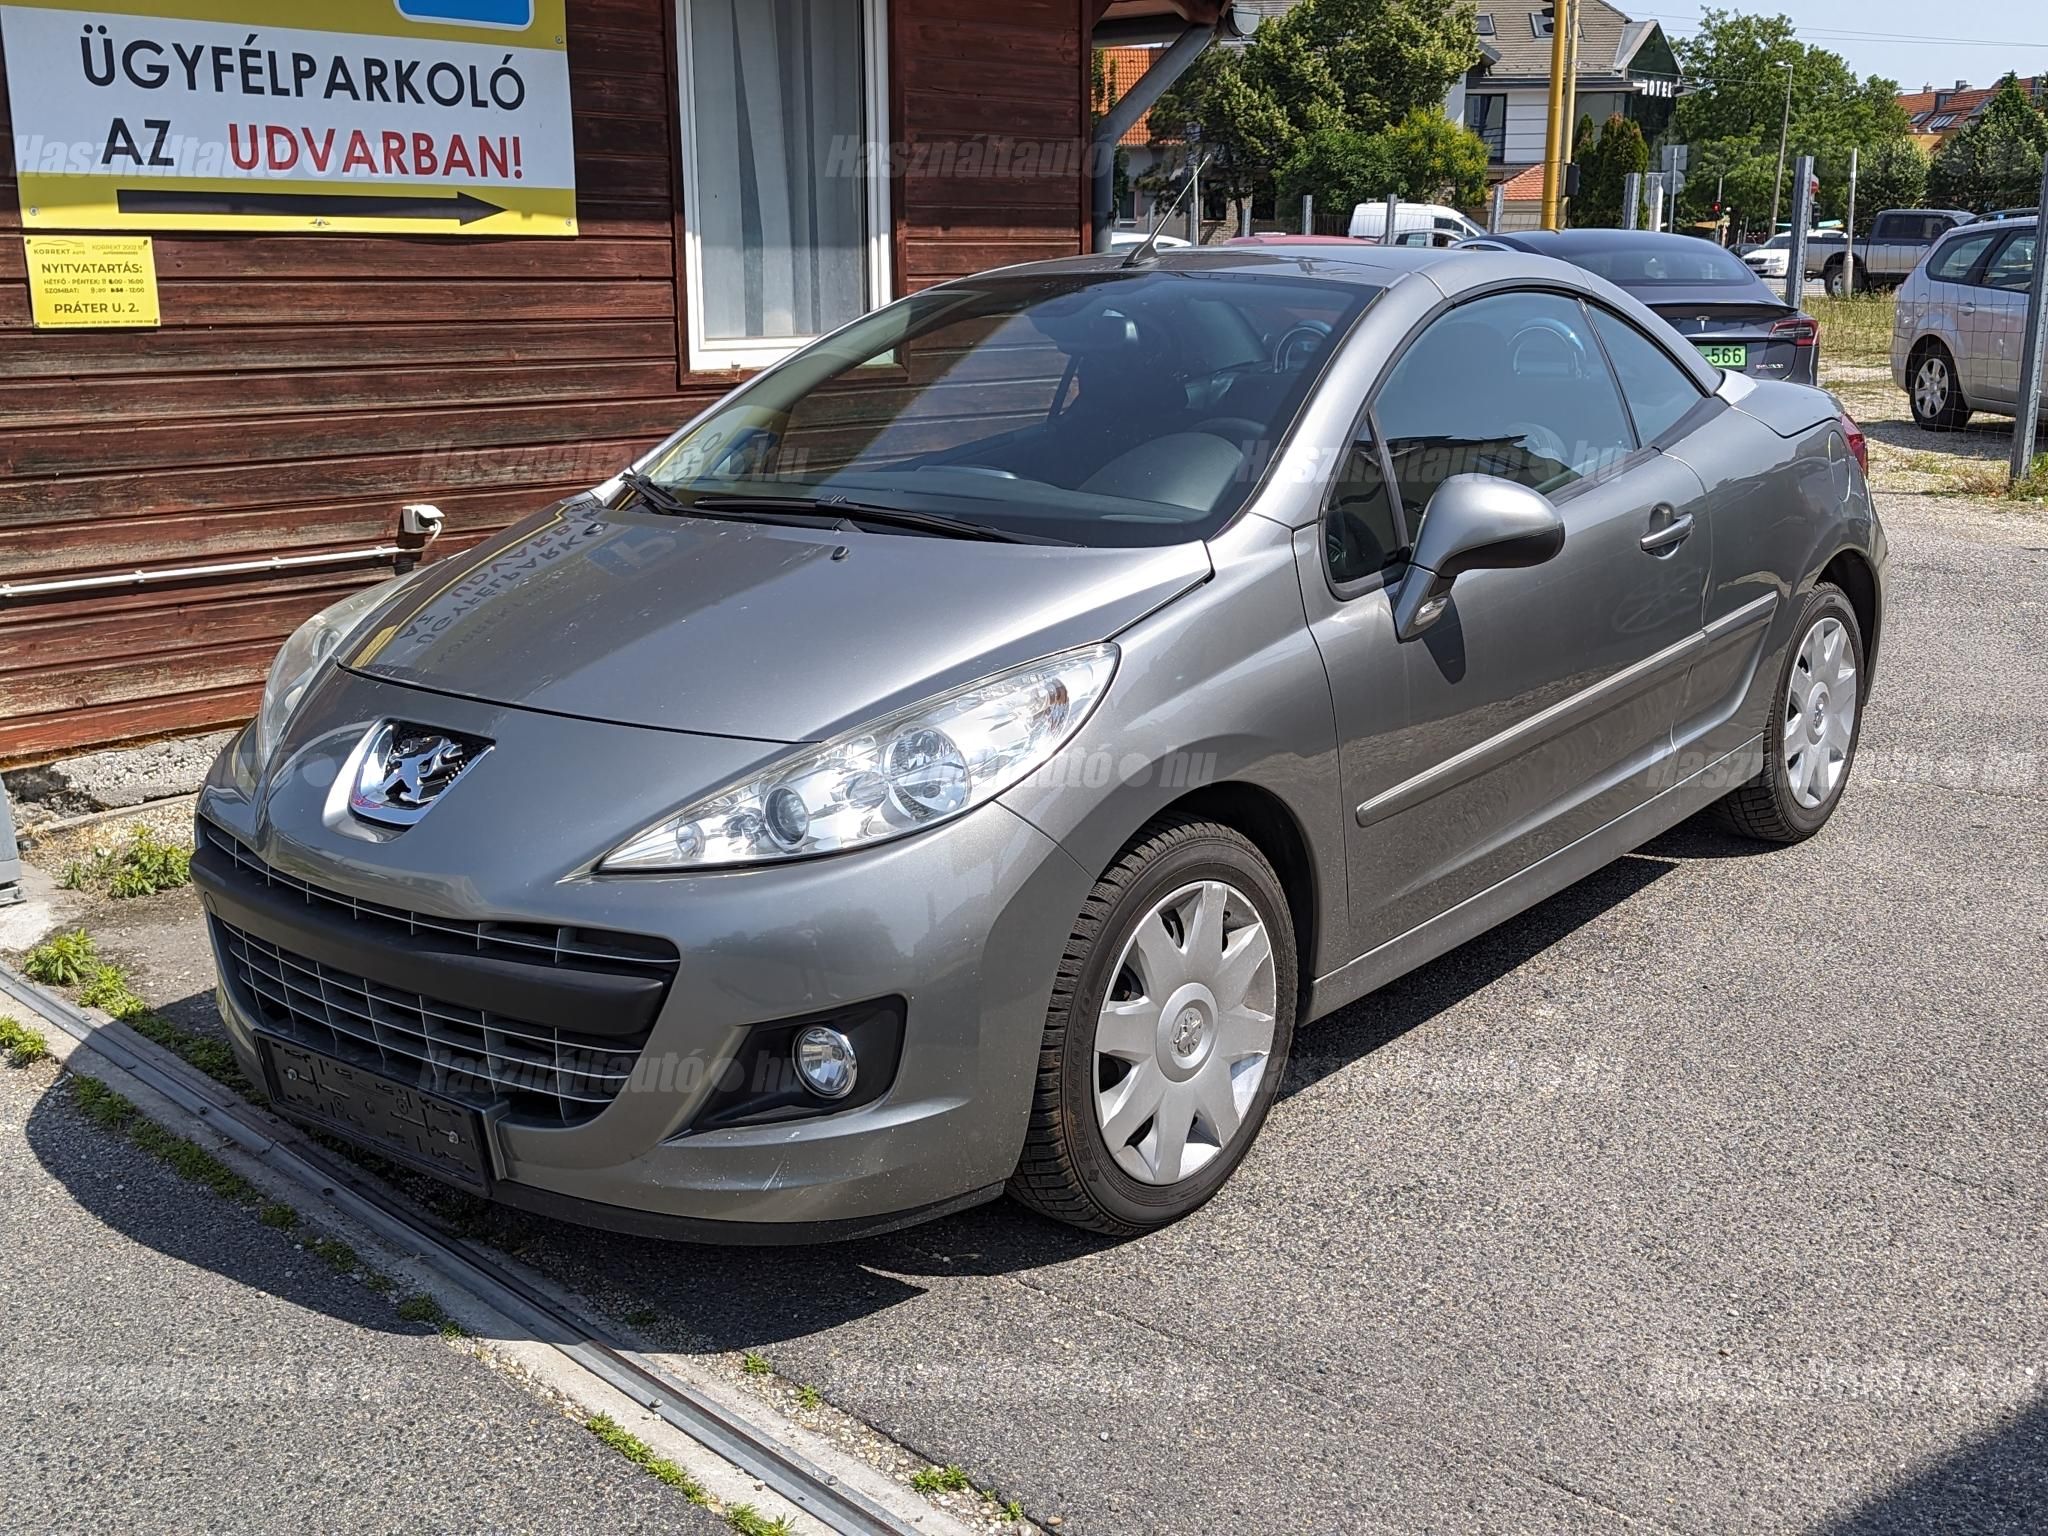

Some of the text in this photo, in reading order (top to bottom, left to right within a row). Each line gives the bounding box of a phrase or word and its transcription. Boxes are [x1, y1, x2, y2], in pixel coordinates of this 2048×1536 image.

[80, 23, 525, 111] ÜGYFÉLPARKOLÓ
[101, 117, 523, 180] AZ UDVARBAN!
[42, 262, 143, 274] NYITVATARTÁS:
[54, 302, 139, 314] PRÁTER U. 2.
